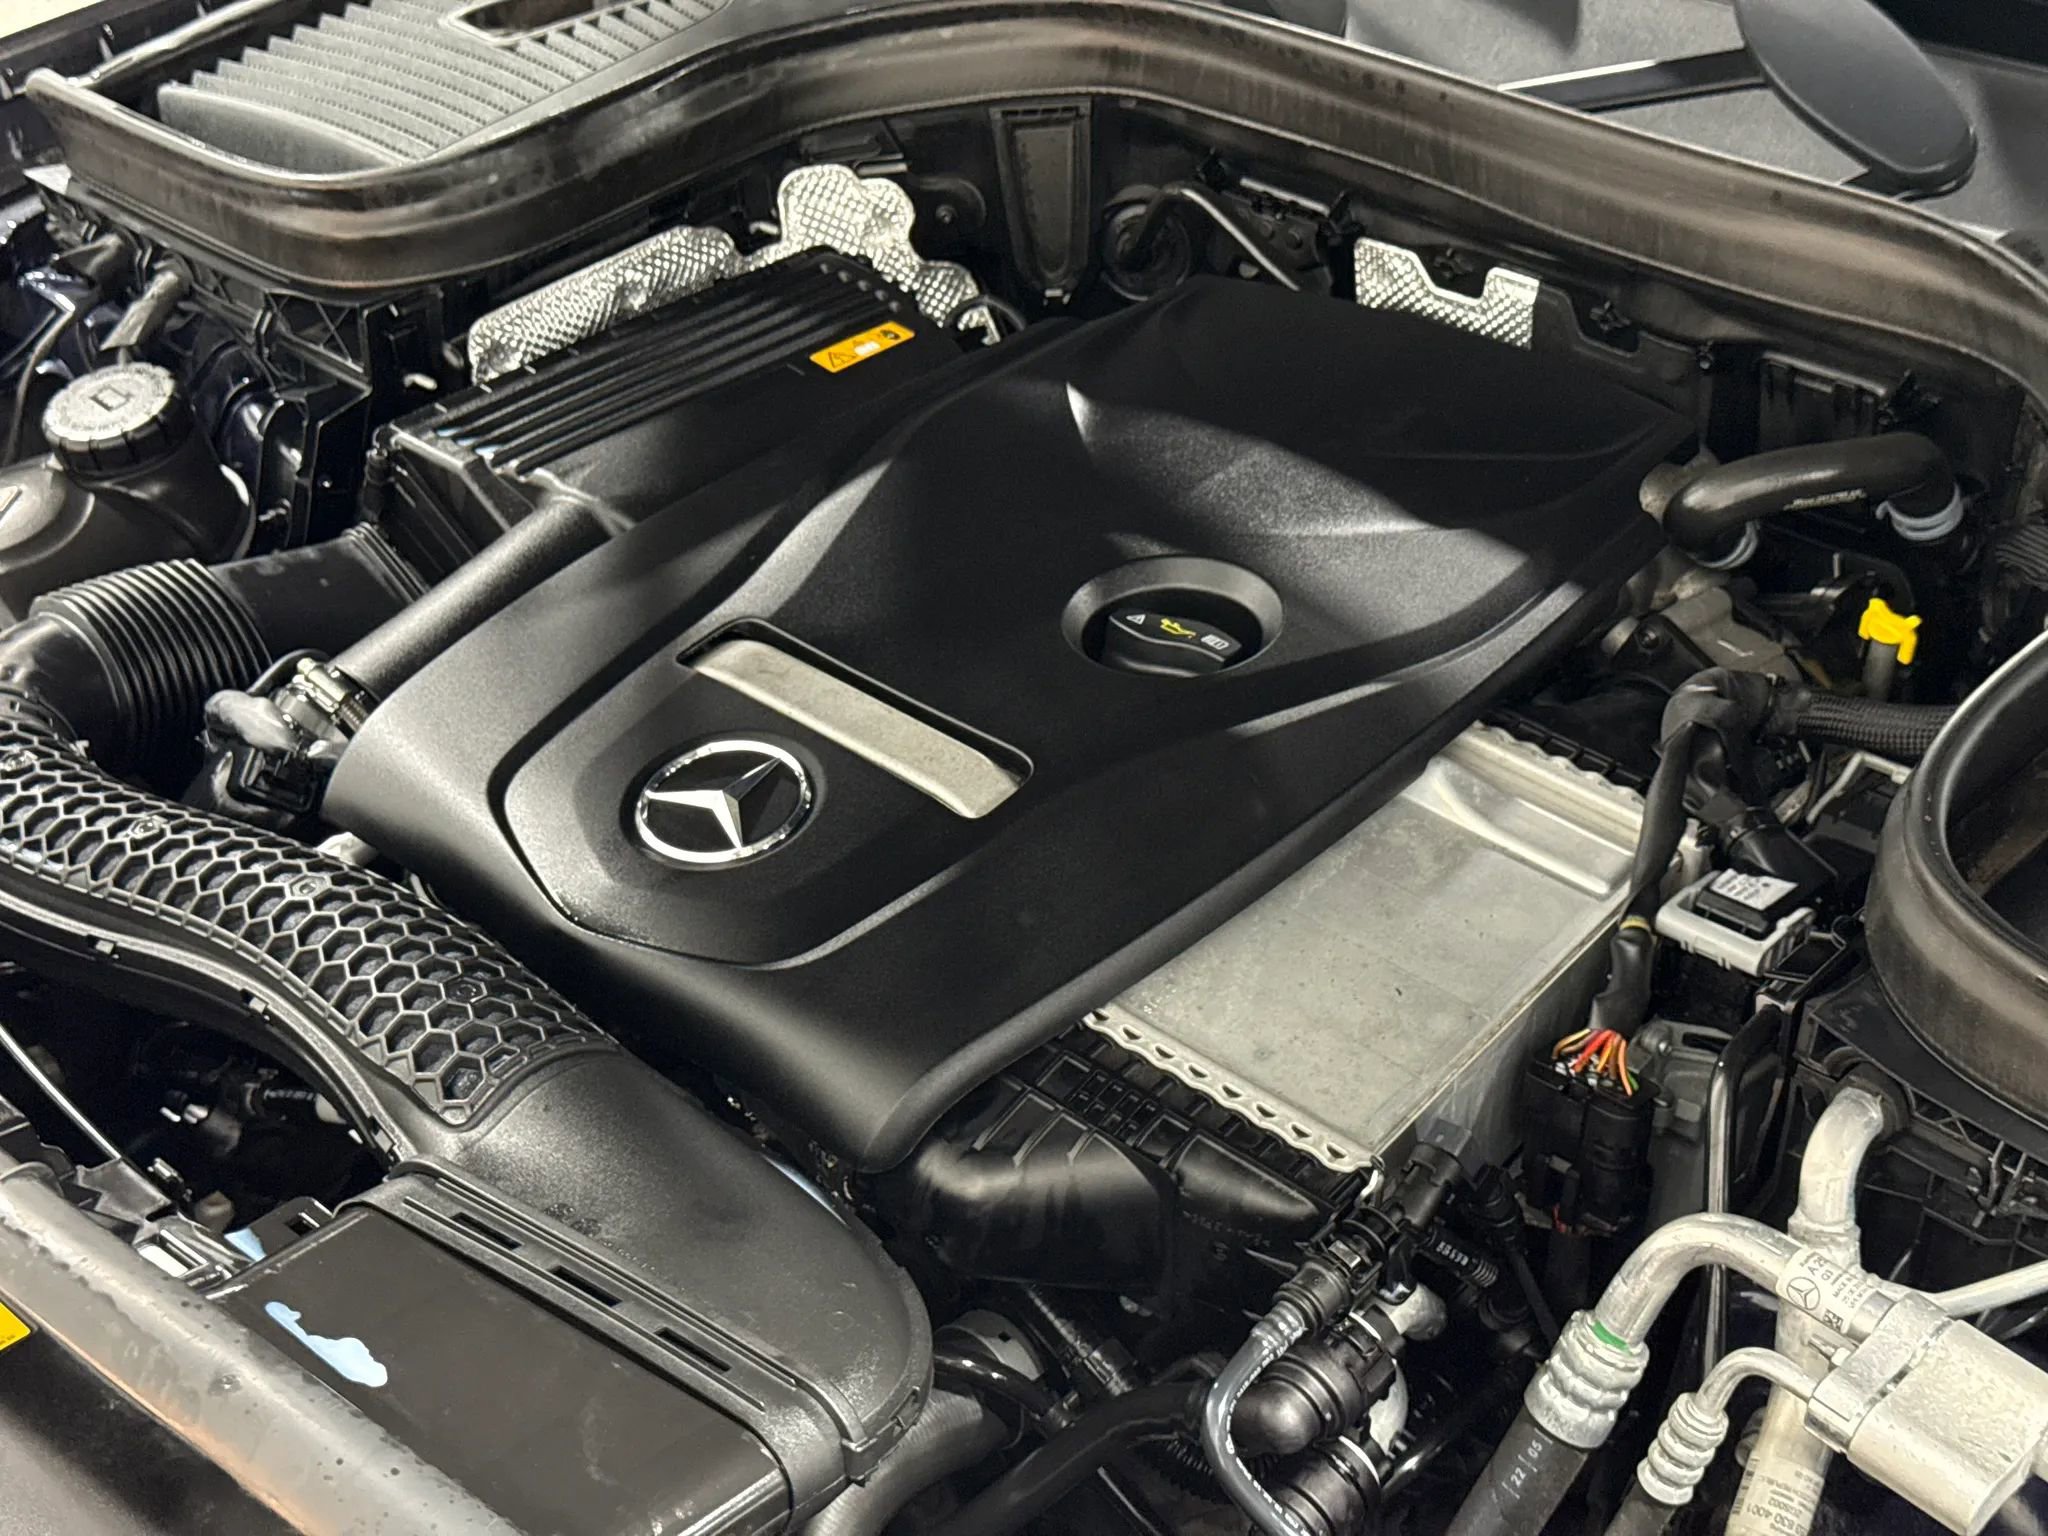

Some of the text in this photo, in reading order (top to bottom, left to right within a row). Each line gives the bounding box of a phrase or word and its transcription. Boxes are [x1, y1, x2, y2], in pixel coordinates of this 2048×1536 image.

[1510, 1439, 1543, 1488] 22 05
[1746, 1503, 1773, 1519] 4001
[1774, 1512, 1796, 1531] 830
